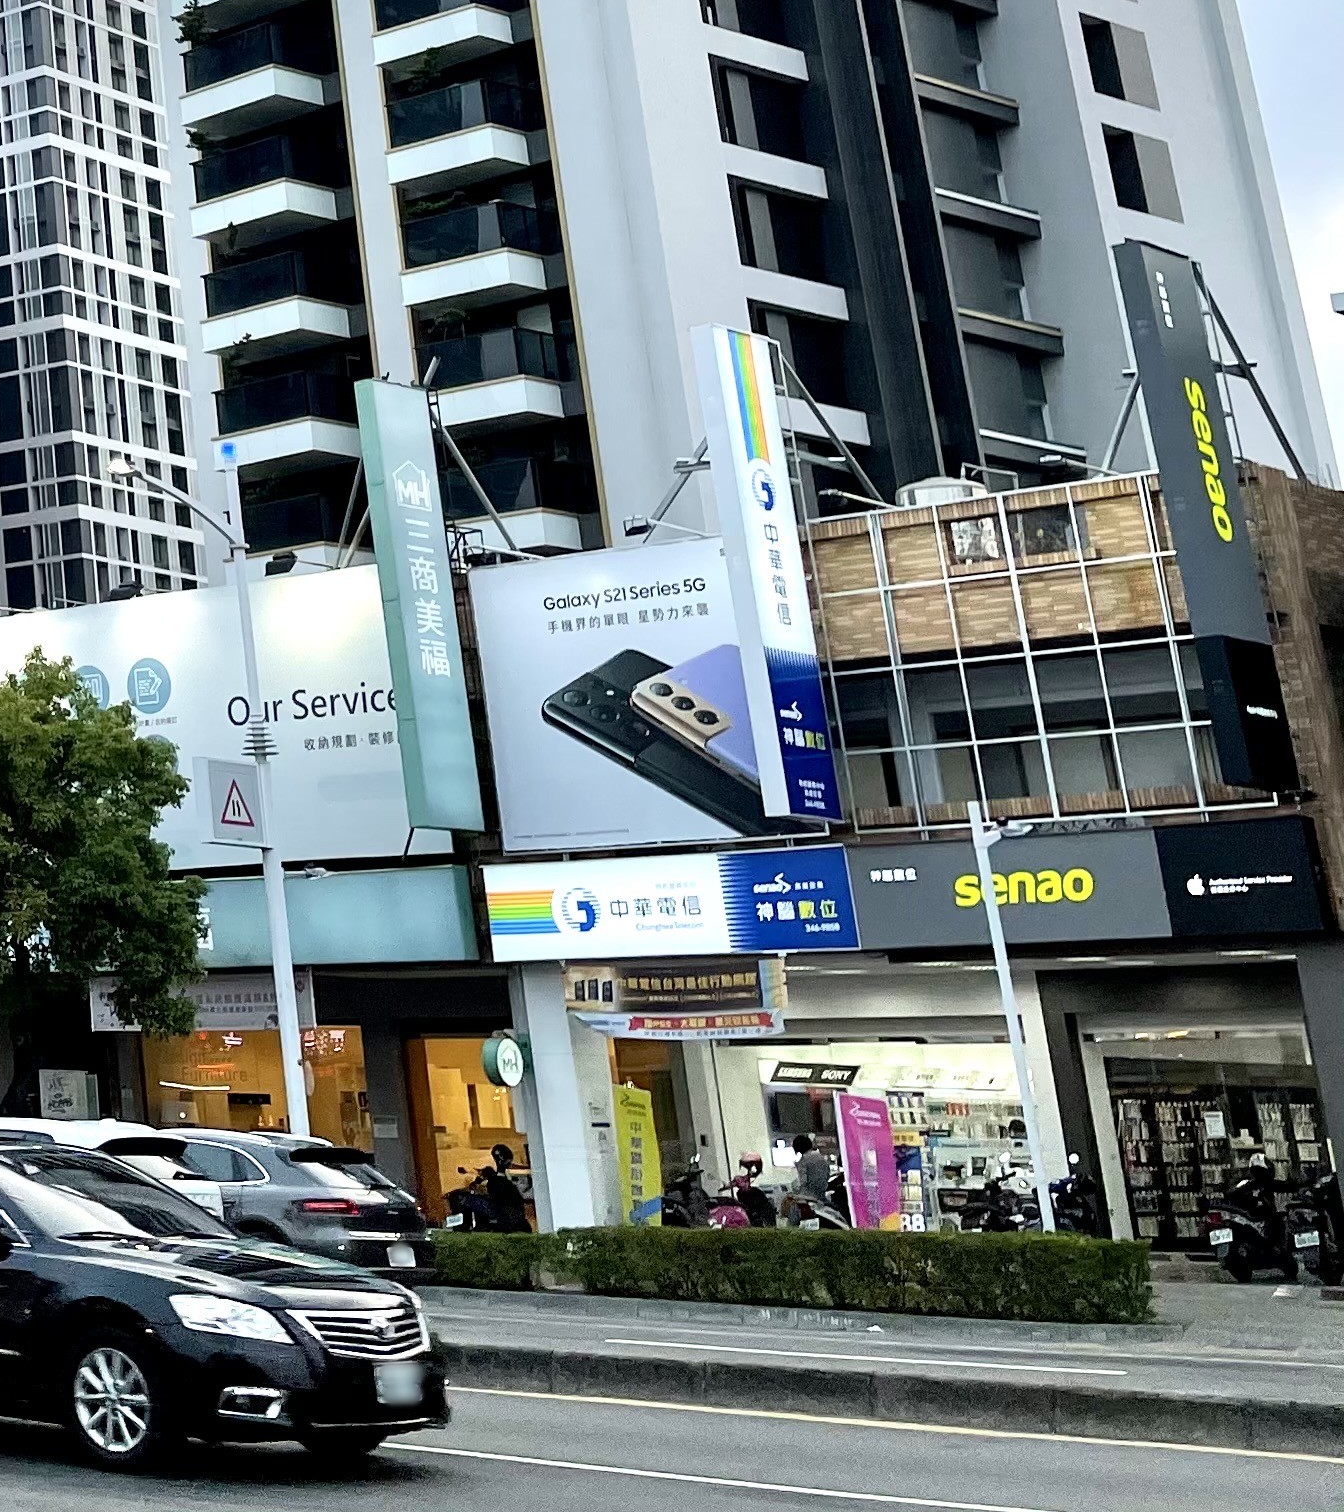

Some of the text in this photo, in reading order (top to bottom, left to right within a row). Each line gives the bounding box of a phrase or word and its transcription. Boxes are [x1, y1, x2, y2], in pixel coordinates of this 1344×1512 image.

[1184, 376, 1234, 543] senao
[543, 577, 706, 610] Galaxy S21 Series 5G
[763, 522, 792, 626] 中華電信
[405, 518, 451, 678] 三商美福
[610, 895, 702, 918] 中華電信
[954, 868, 1094, 908] senao
[820, 1069, 852, 1081] SONY
